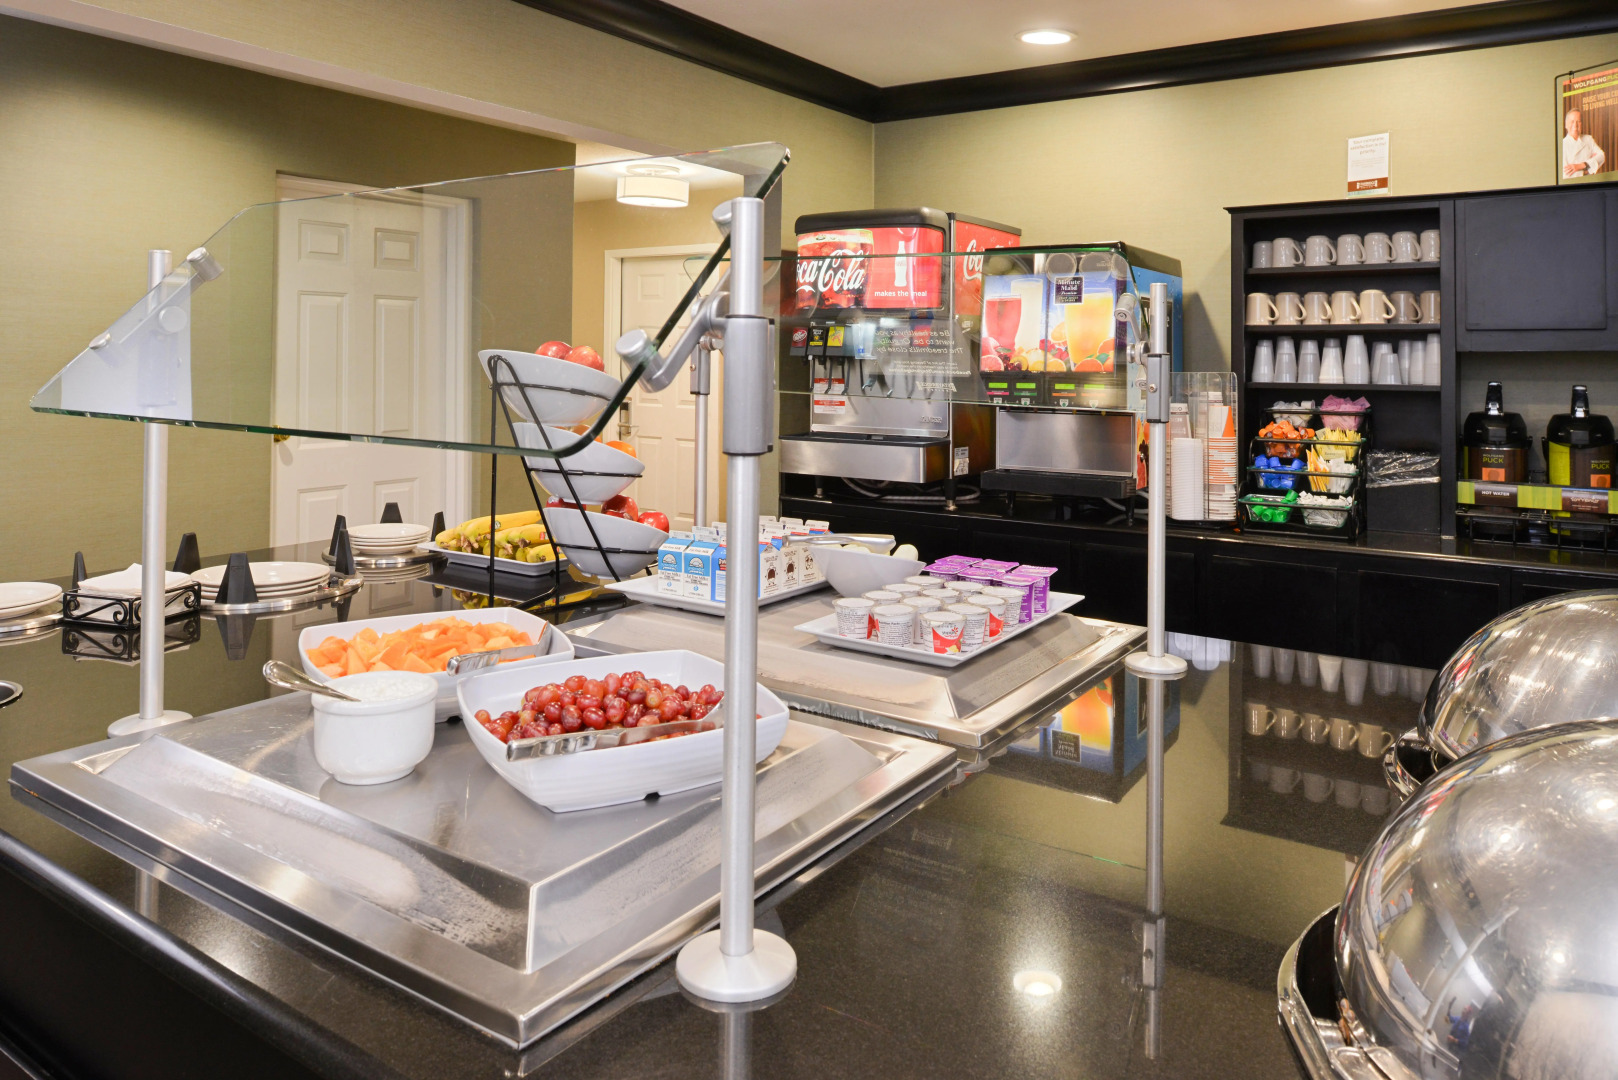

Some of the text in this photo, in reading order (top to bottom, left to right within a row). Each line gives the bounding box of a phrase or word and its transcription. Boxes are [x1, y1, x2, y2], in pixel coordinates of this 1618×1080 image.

[1574, 76, 1607, 89] WOLFGANG
[1582, 94, 1597, 104] RAISE
[1597, 91, 1610, 101] YOUR
[1583, 103, 1588, 111] TO
[1590, 100, 1606, 110] LIVING
[796, 248, 869, 292] oca-Cola
